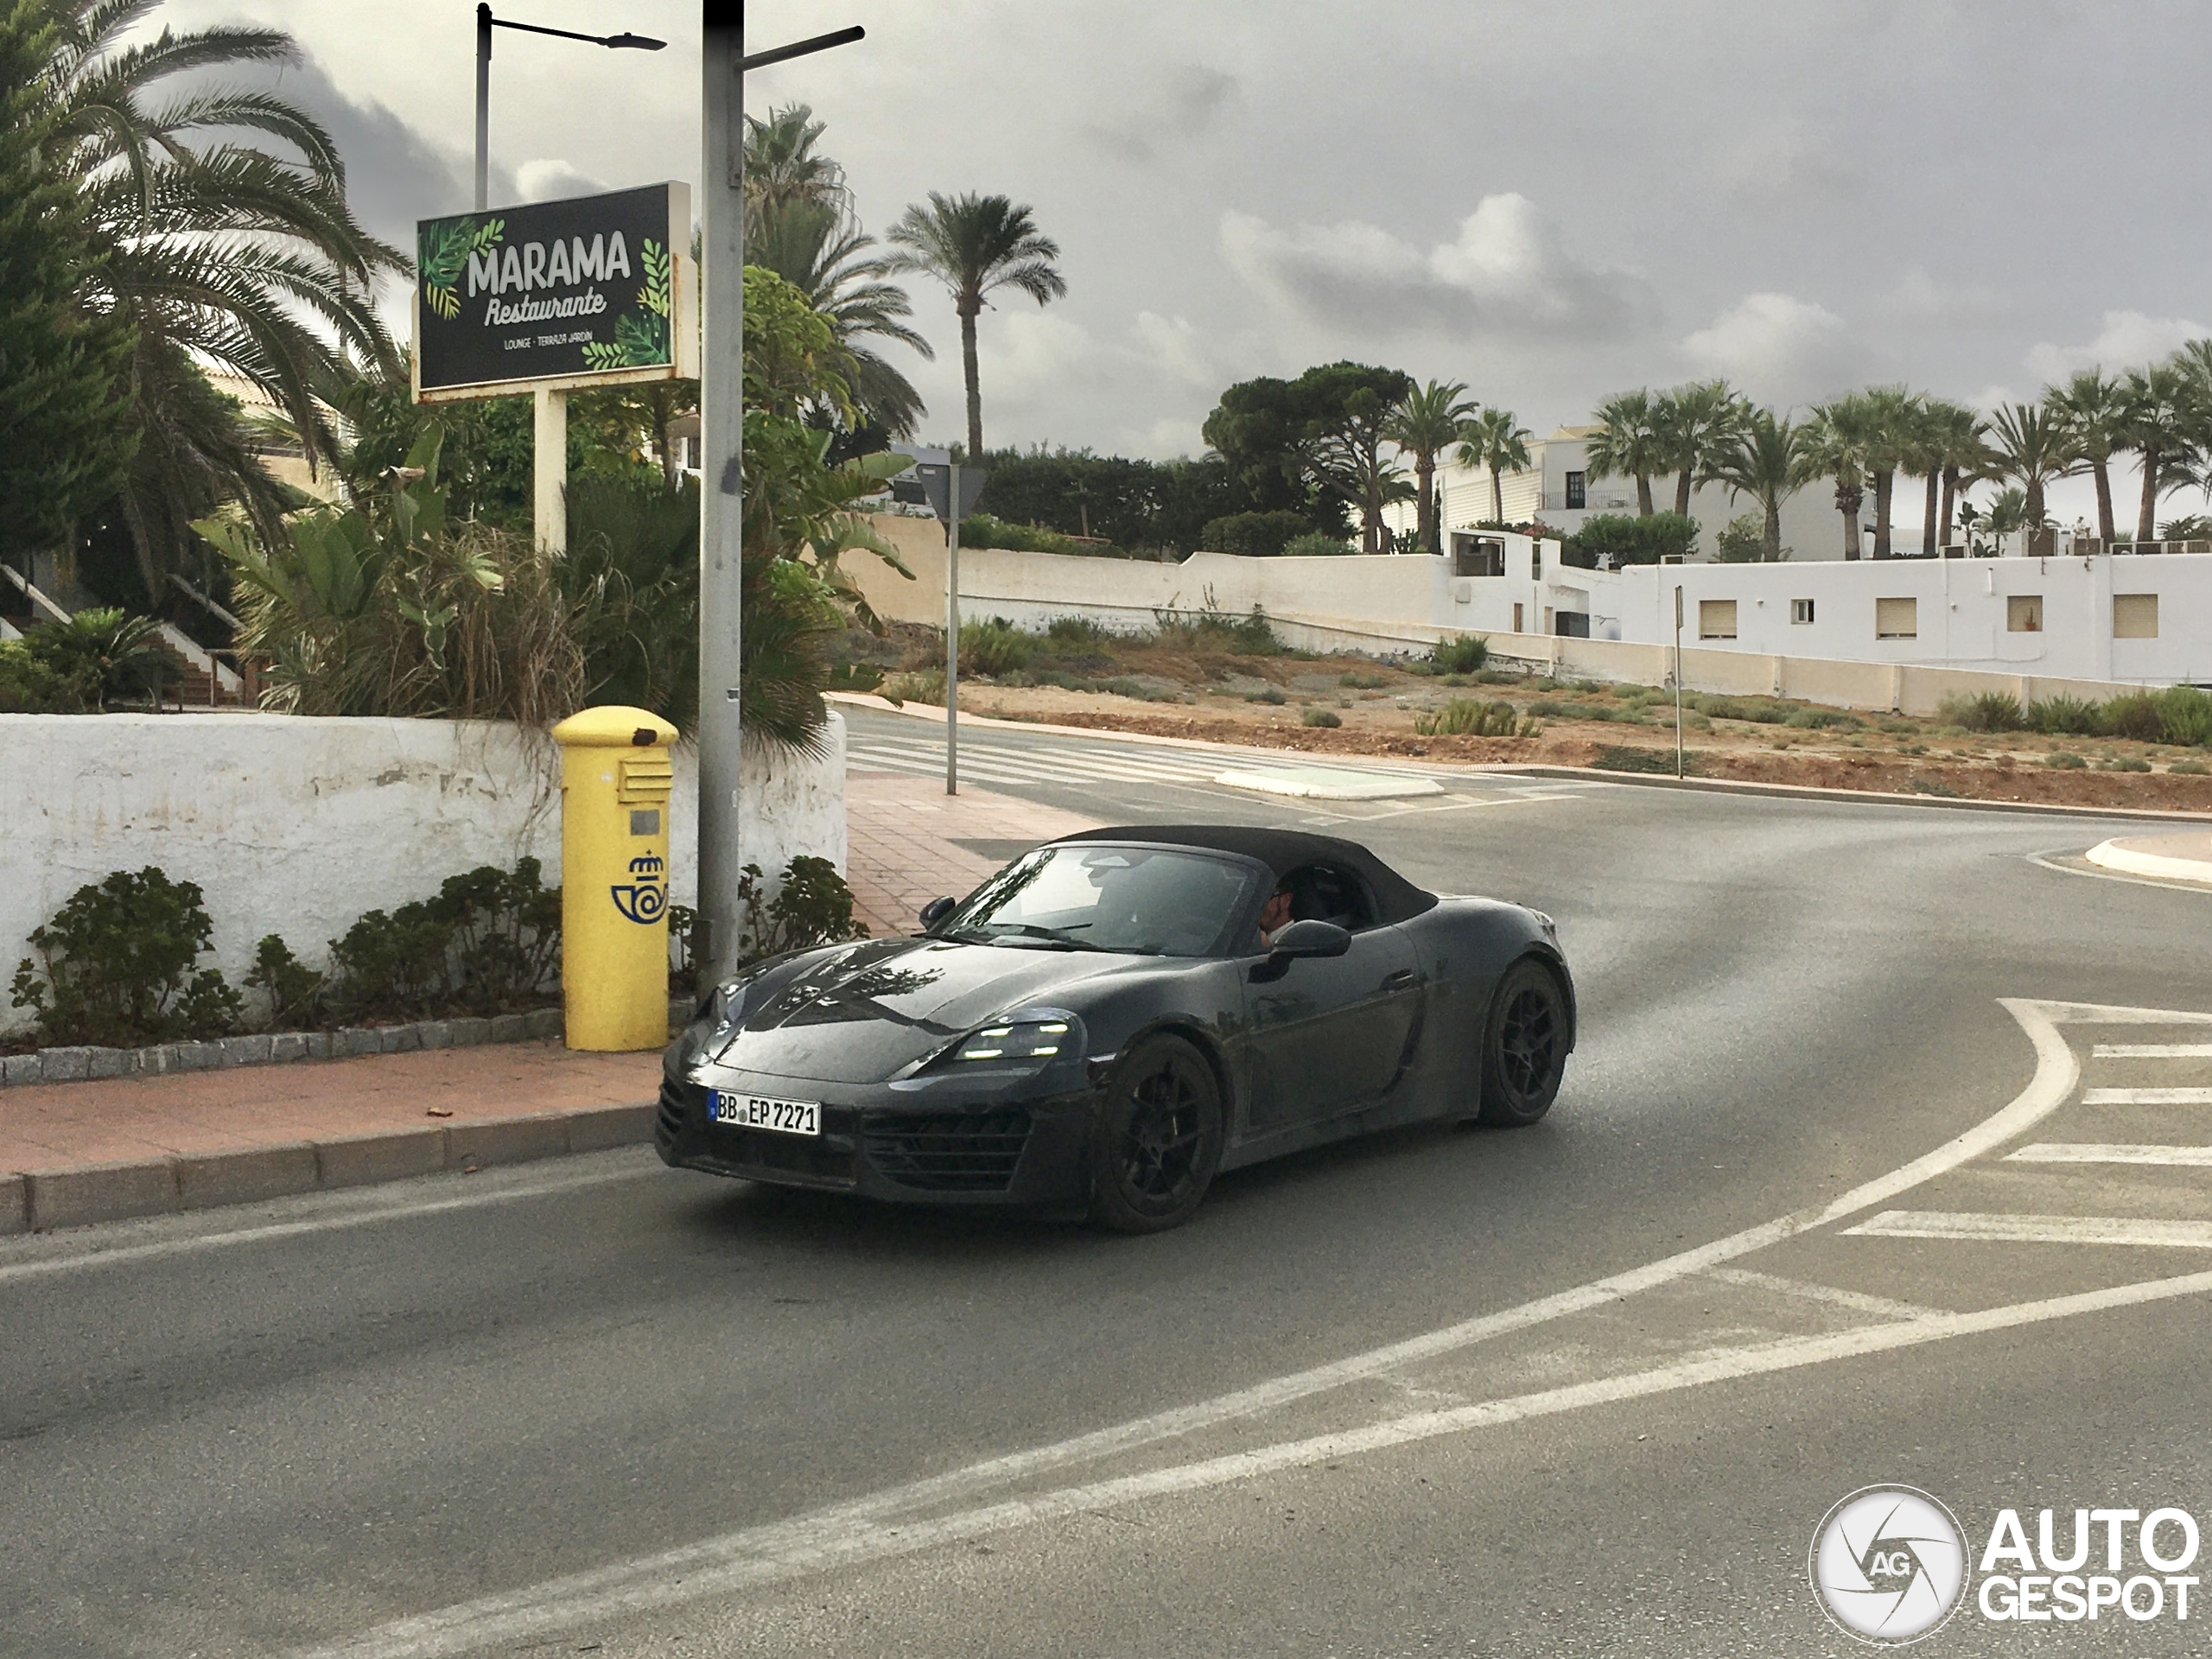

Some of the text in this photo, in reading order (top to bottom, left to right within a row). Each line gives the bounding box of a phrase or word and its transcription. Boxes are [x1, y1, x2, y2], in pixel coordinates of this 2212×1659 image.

[467, 230, 632, 297] MARAMA
[484, 286, 607, 327] Restaurante
[504, 337, 531, 351] LOUNGE
[537, 333, 567, 346] TERRAZA
[718, 1094, 816, 1132] BB EP 7271
